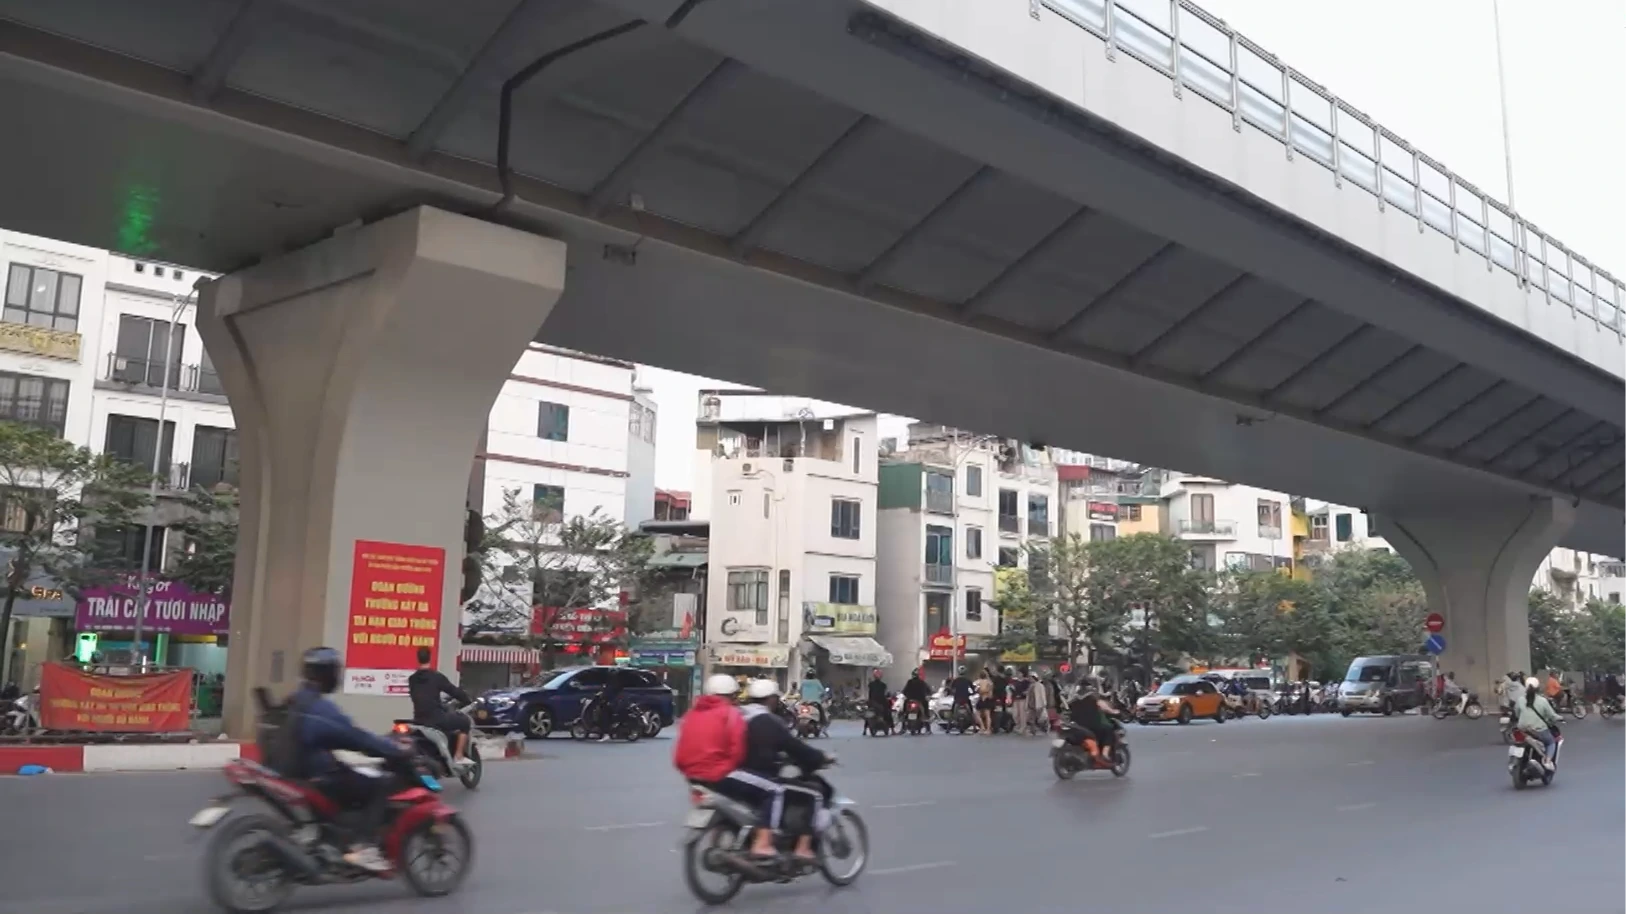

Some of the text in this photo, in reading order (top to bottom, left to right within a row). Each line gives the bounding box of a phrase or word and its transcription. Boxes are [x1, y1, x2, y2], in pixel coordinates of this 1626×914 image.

[127, 575, 154, 594] Kig
[87, 595, 119, 618] TRÁI
[155, 598, 185, 620] TƯƠI
[190, 598, 225, 625] NHẬP
